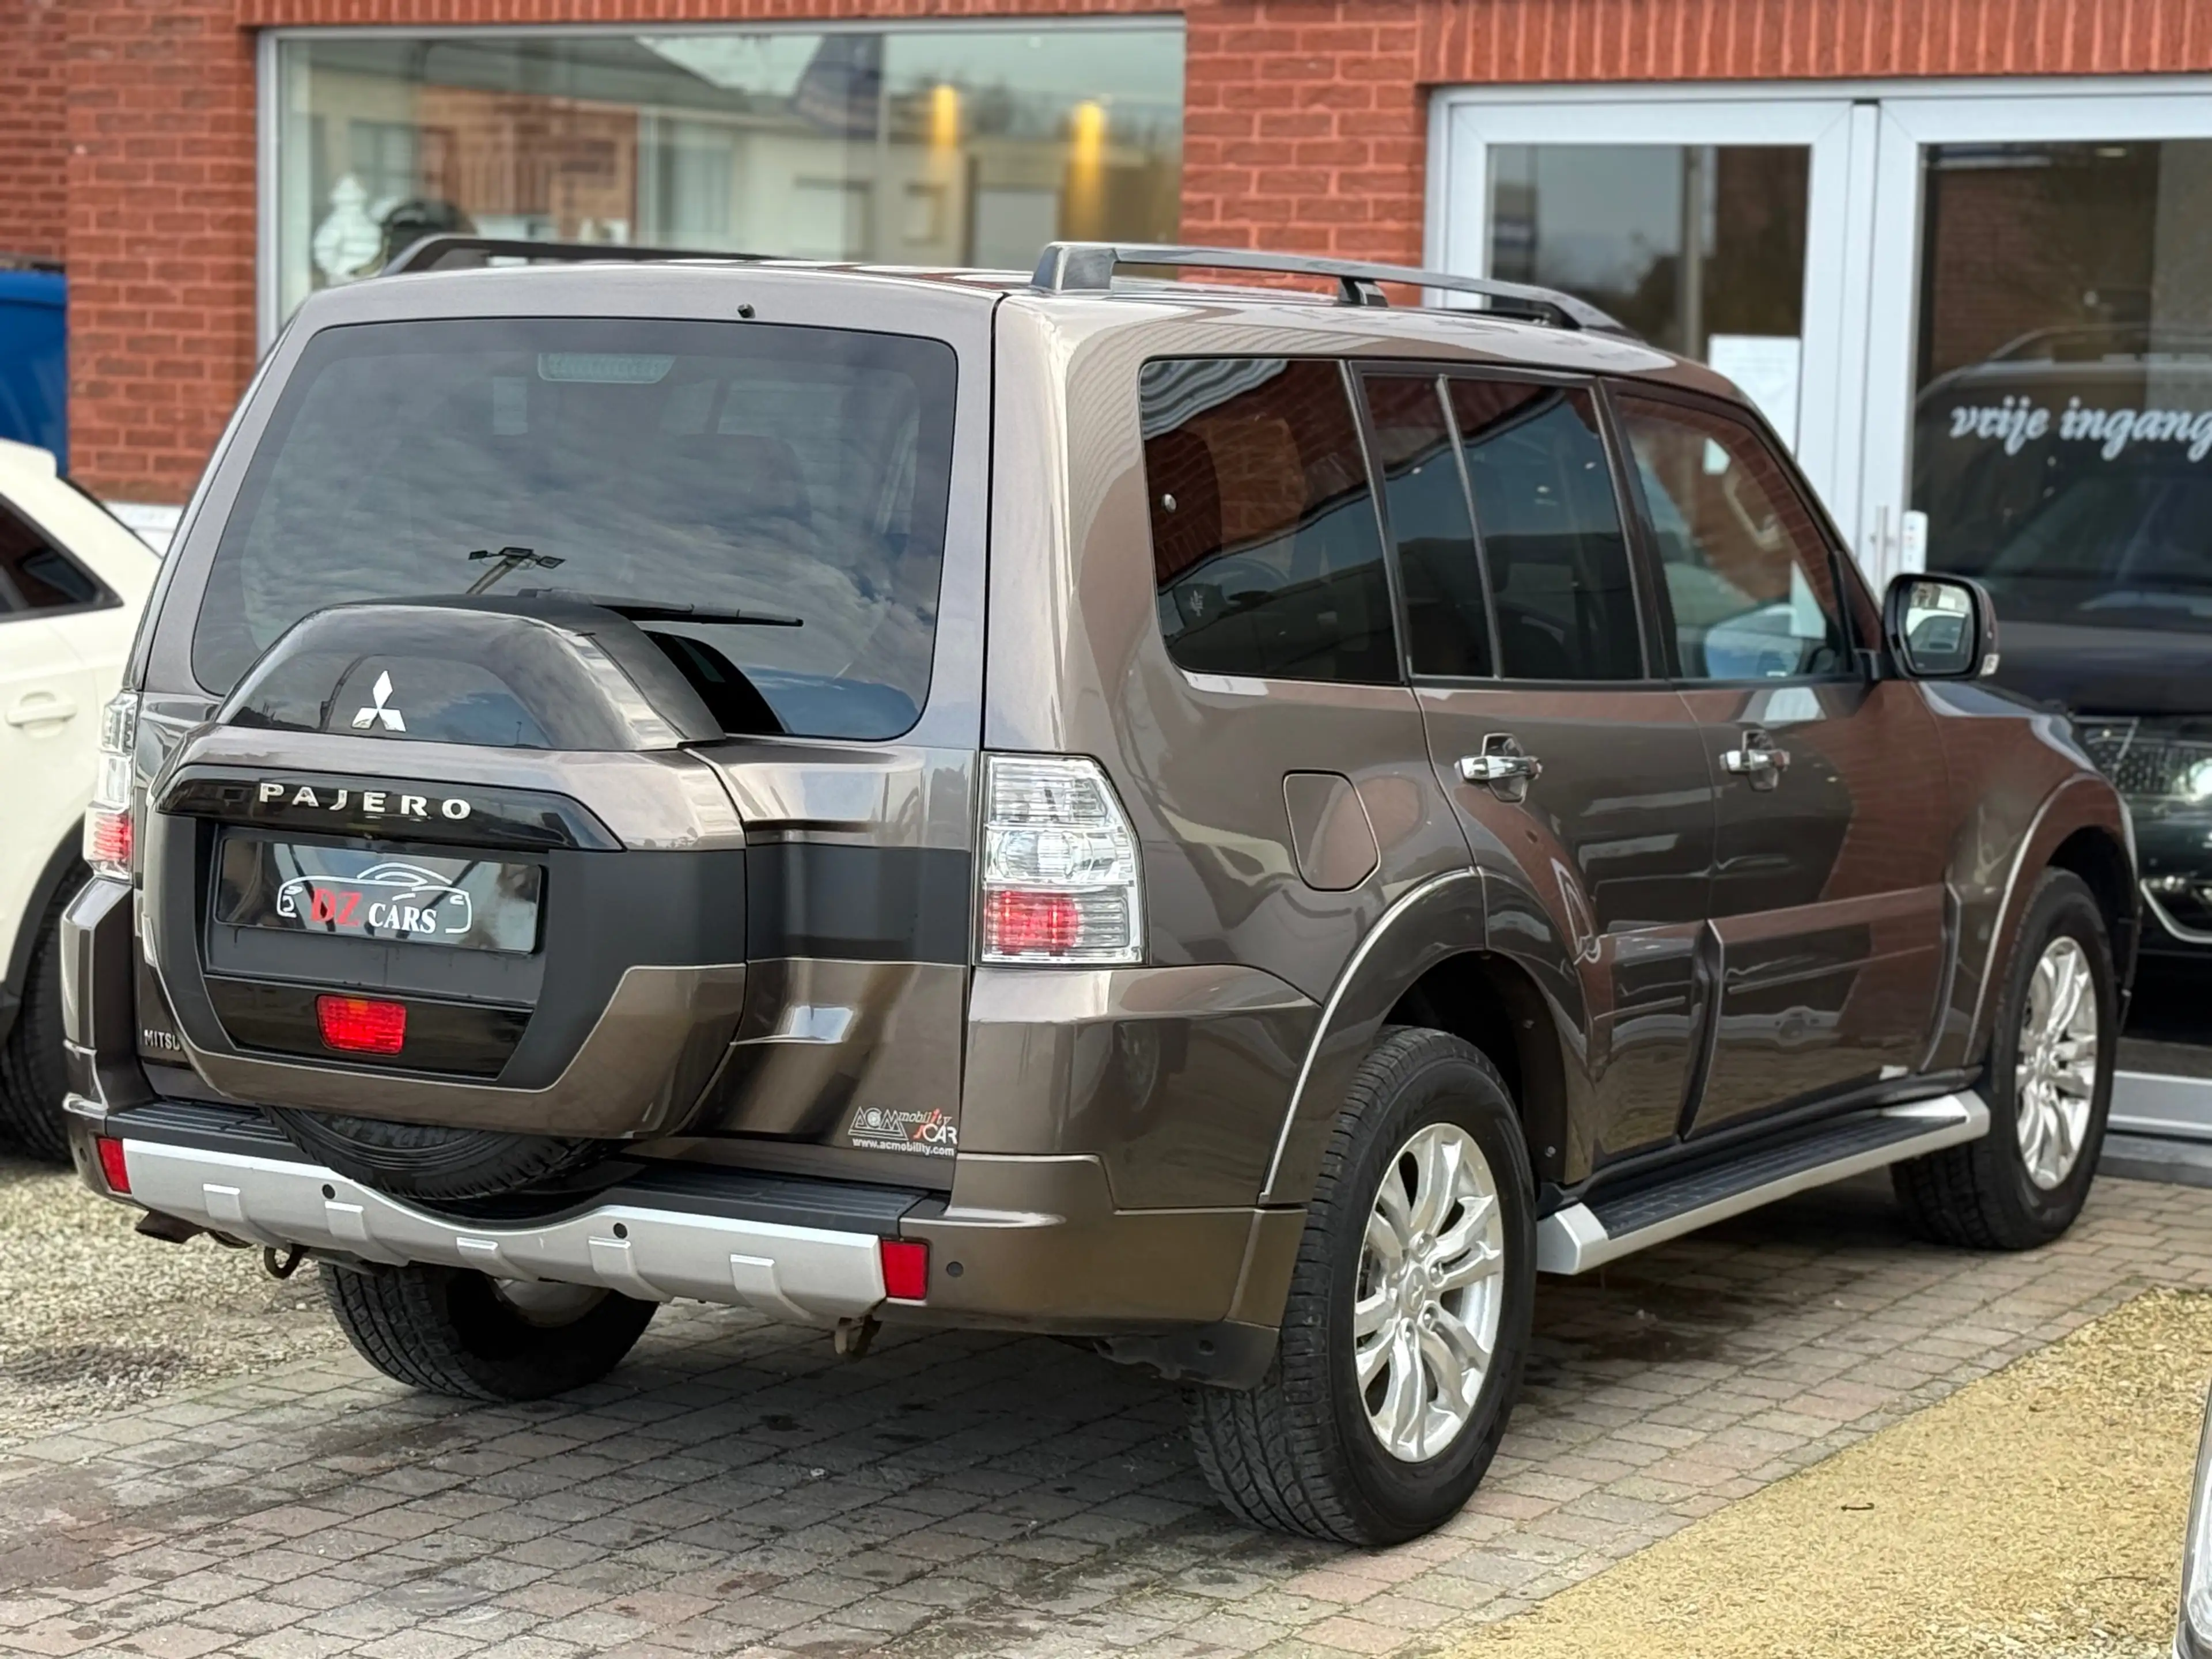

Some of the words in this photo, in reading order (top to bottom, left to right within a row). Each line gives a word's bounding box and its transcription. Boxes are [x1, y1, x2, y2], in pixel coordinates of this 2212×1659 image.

[1949, 395, 2051, 456] vrije
[2060, 396, 2212, 462] ingang
[259, 782, 471, 820] PAJERO
[310, 886, 363, 926] DZ
[368, 902, 438, 933] CARS
[853, 1138, 955, 1157] www.acmobility.com
